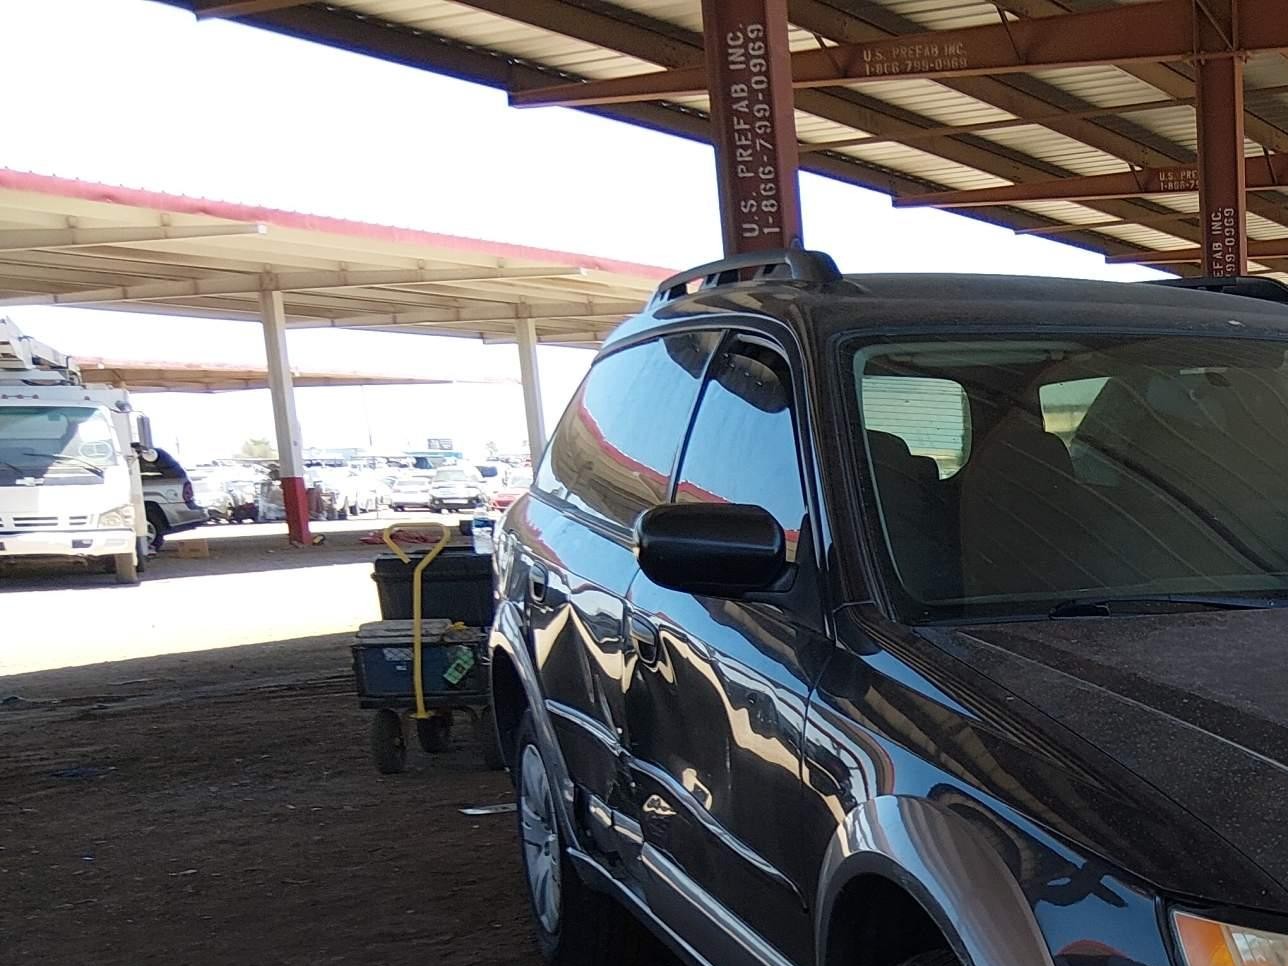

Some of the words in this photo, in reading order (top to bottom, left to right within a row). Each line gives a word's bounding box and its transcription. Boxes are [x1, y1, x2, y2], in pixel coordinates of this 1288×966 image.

[726, 23, 747, 70] INC.
[893, 44, 939, 59] PREFAB
[730, 83, 755, 178] PREFAB
[747, 24, 781, 235] 1-866-799-0969
[1180, 169, 1199, 180] PRE
[740, 191, 760, 237] U.S.
[1211, 207, 1223, 235] INC.
[1212, 242, 1224, 278] EFAB
[1223, 207, 1236, 277] 99-0969
